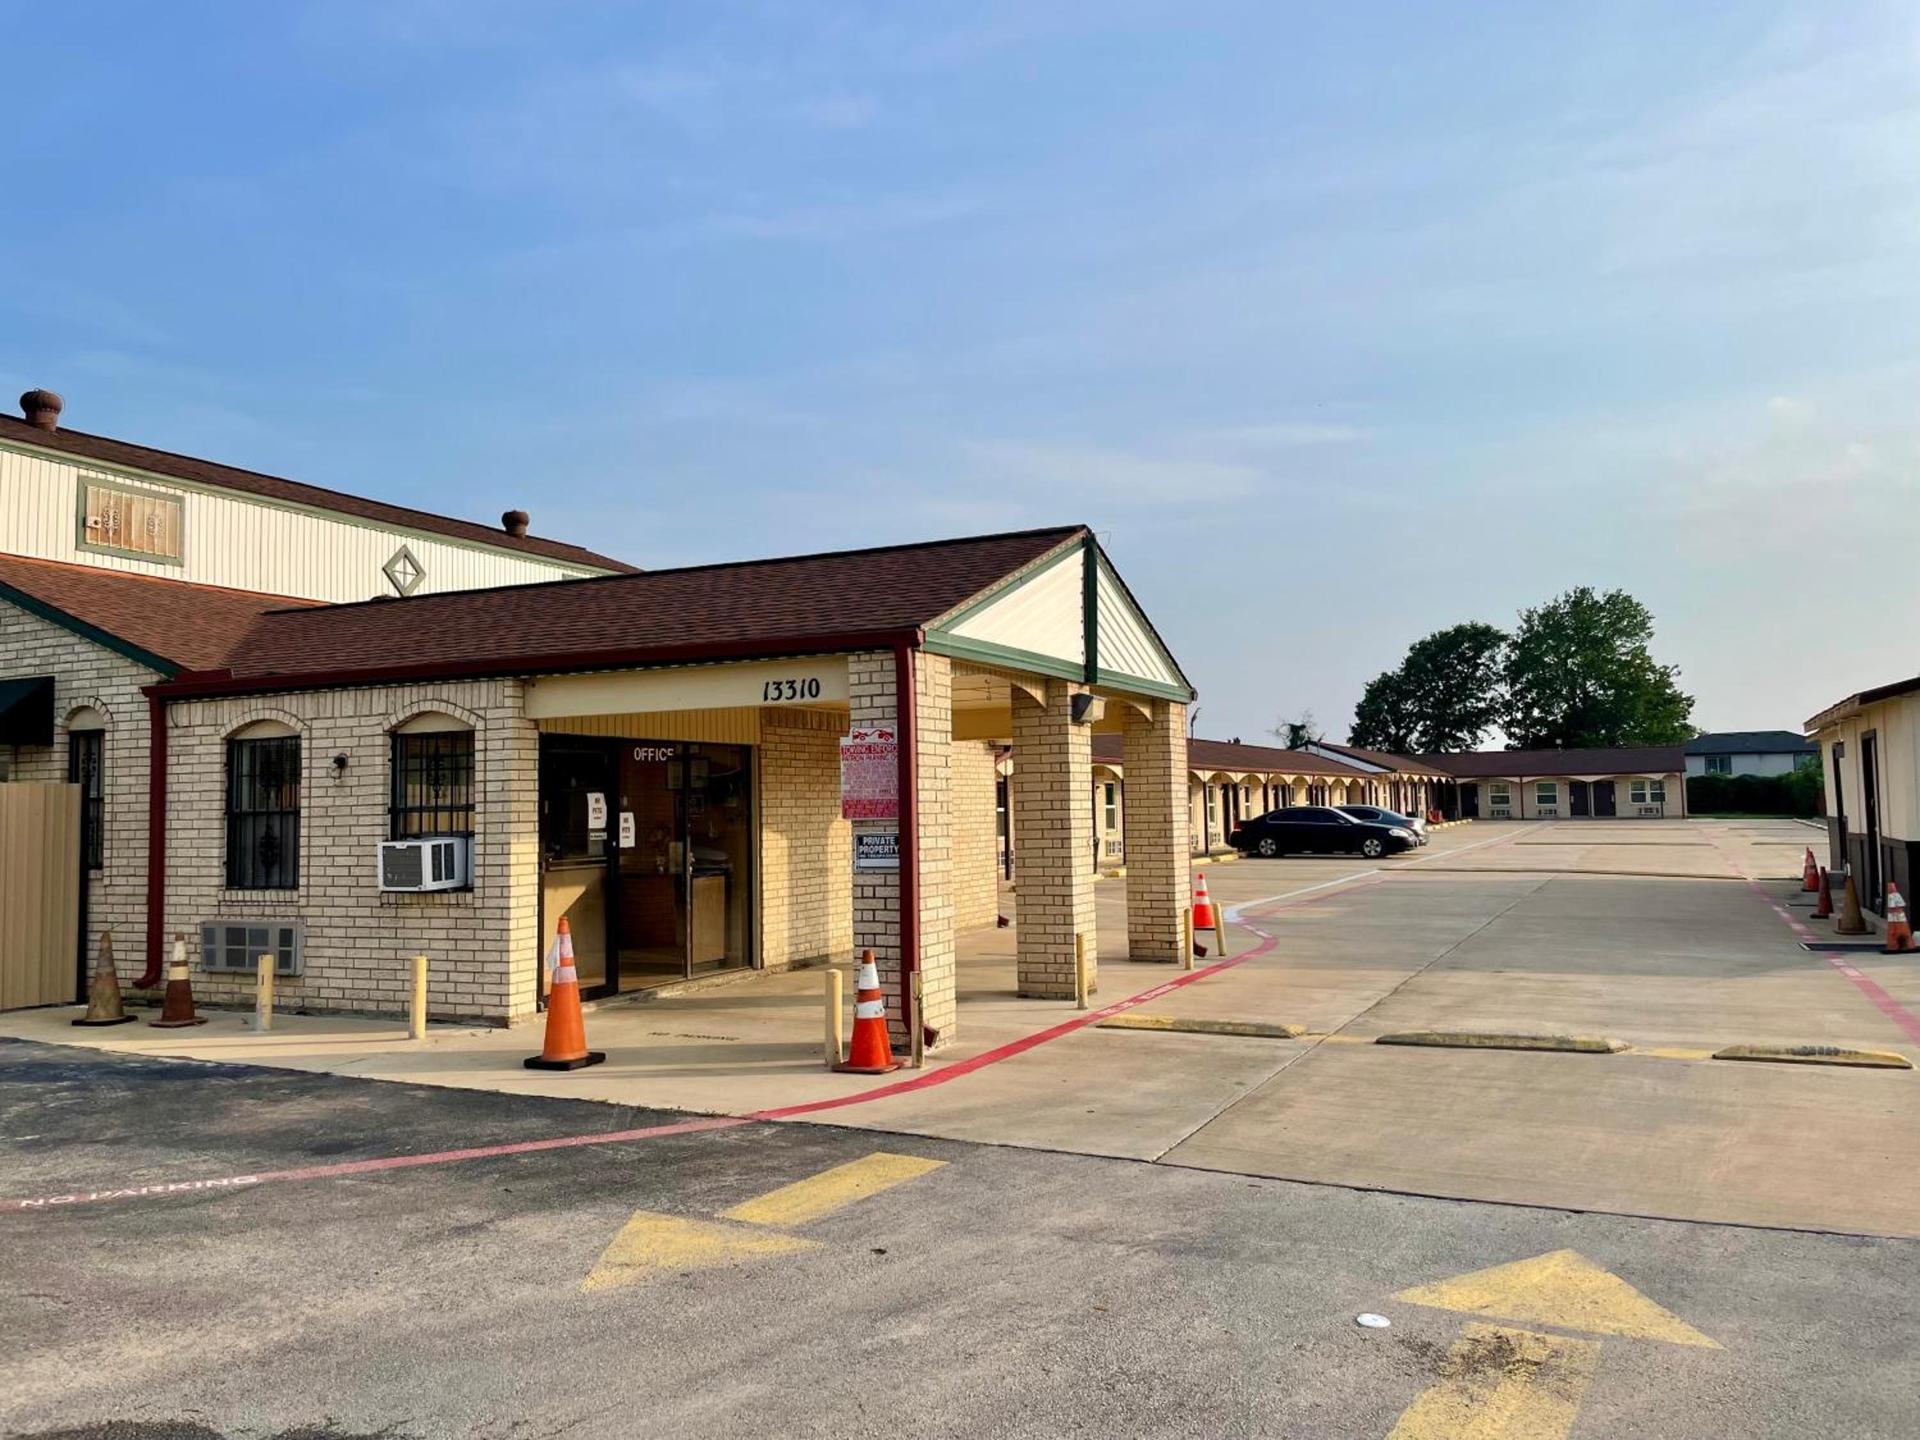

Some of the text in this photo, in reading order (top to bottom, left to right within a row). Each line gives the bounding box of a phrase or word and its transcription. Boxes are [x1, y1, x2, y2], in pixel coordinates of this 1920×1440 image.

[764, 677, 820, 701] 13310
[863, 836, 895, 845] PRIVATE
[859, 845, 899, 854] PROPERTY
[20, 1175, 258, 1207] NO PARKING
